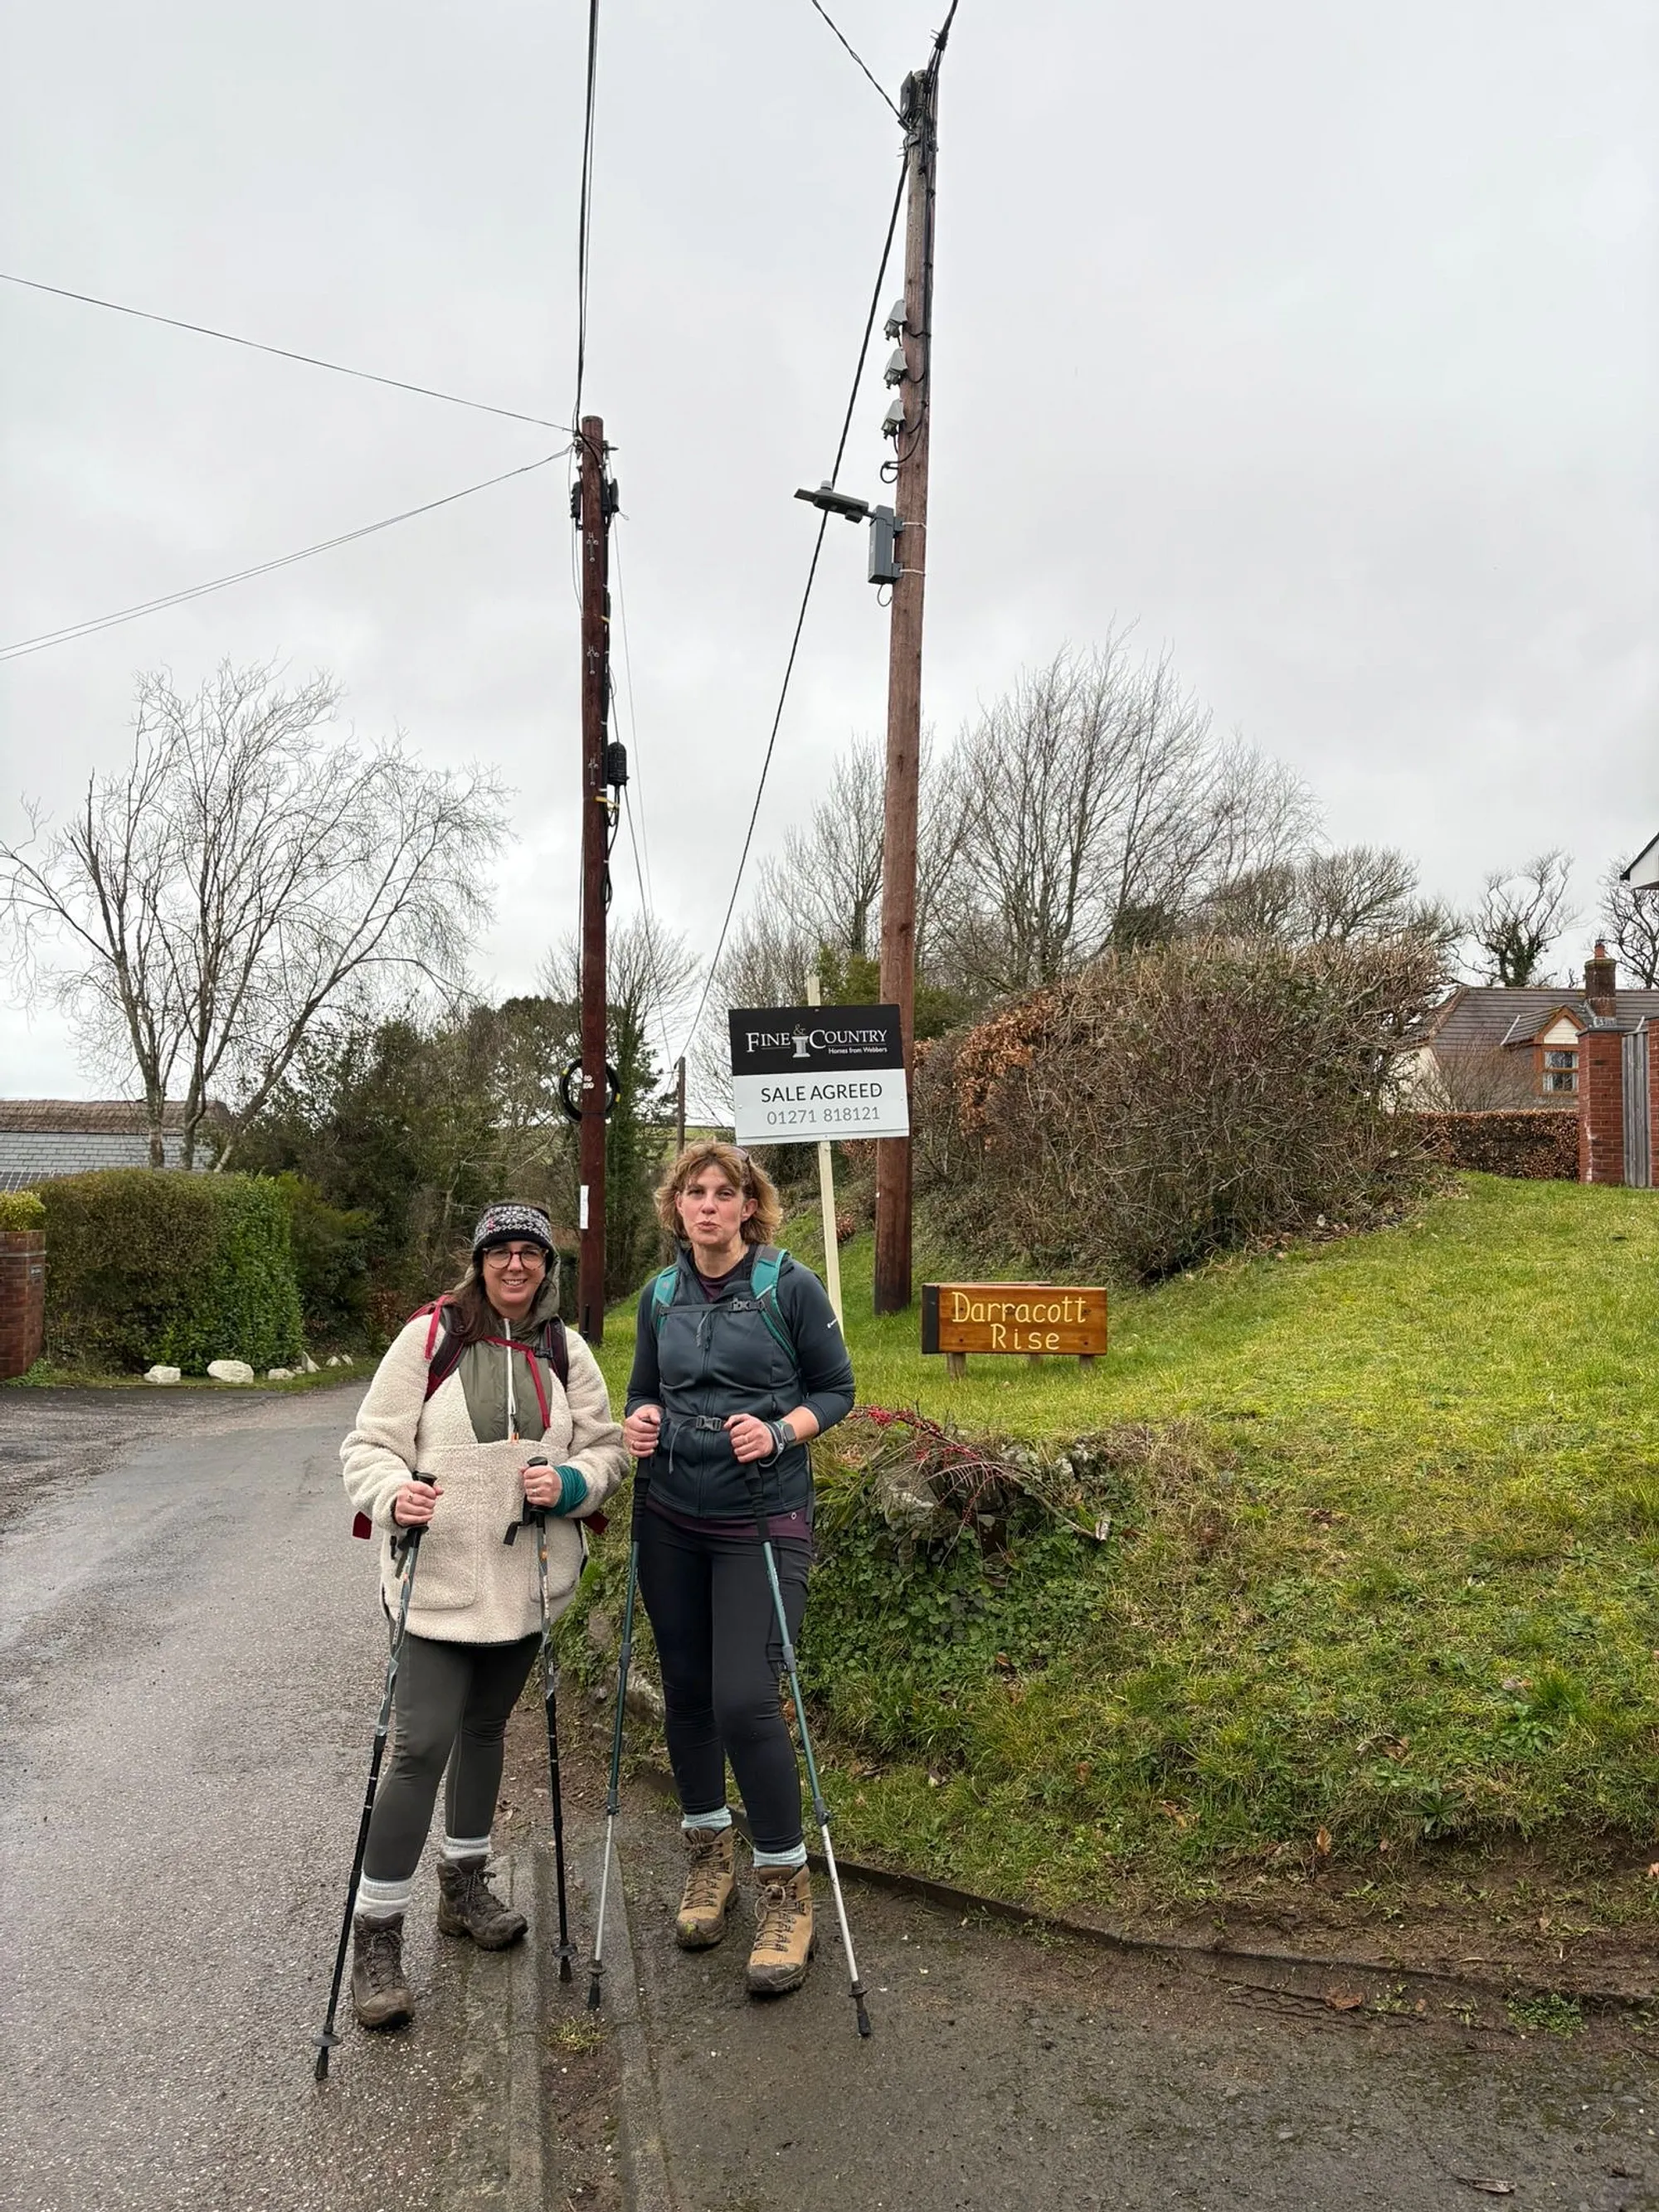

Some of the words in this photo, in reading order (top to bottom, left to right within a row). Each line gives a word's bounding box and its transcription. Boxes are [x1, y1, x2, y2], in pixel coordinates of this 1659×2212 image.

[746, 1032, 791, 1053] FINE
[810, 1029, 888, 1049] COUNTRY
[761, 1086, 806, 1103] SALE
[810, 1082, 883, 1101] AGREED
[766, 1109, 817, 1125] 01271
[823, 1106, 880, 1122] 818121
[951, 1291, 1087, 1323] Darracott
[990, 1323, 1060, 1350] Rise
